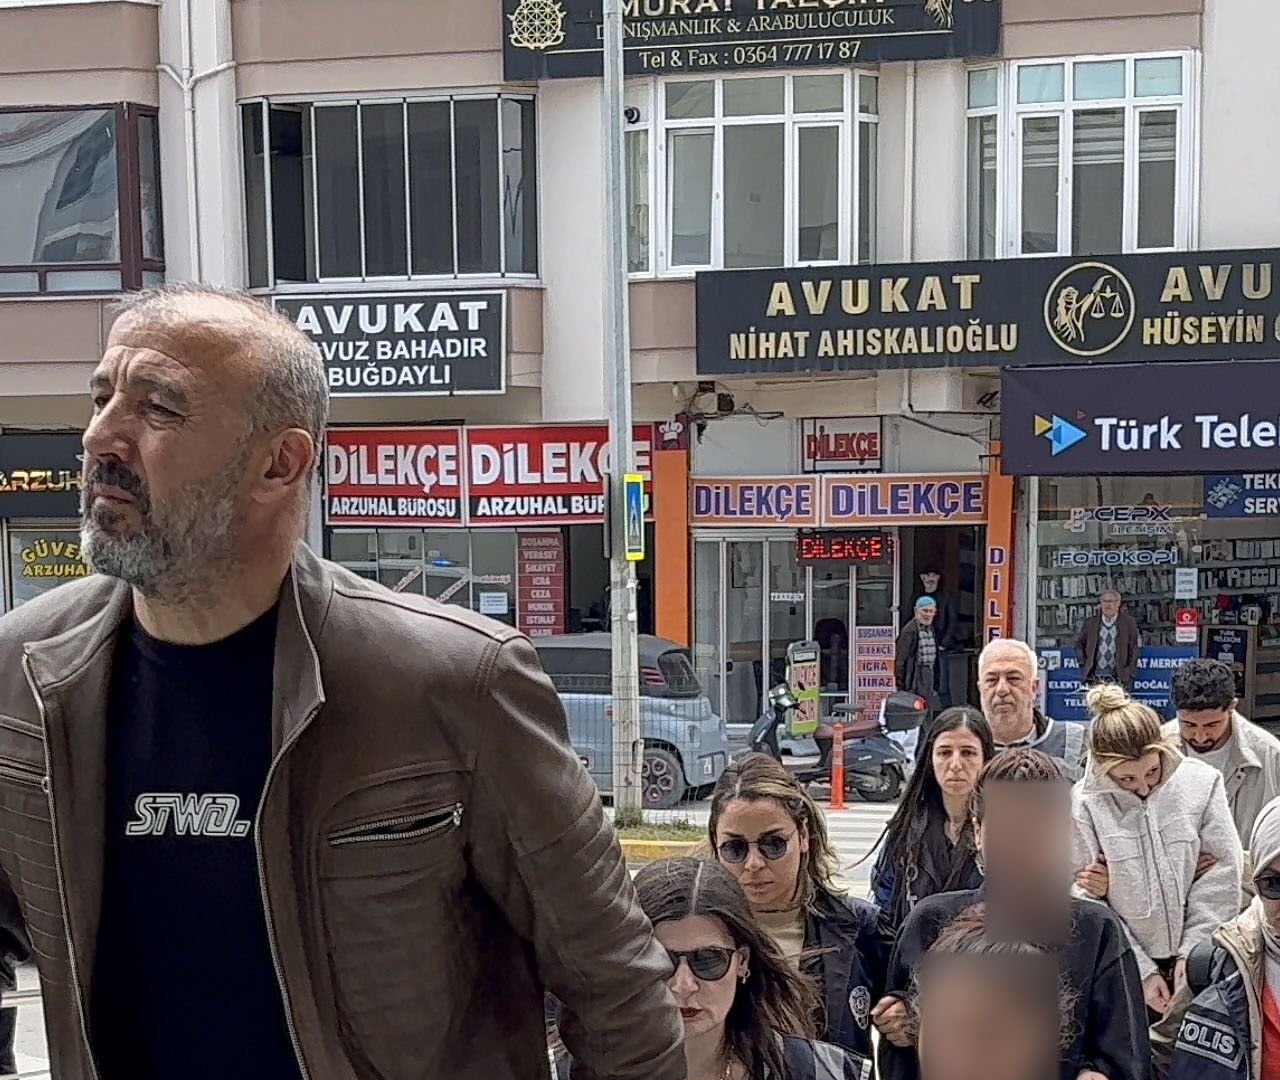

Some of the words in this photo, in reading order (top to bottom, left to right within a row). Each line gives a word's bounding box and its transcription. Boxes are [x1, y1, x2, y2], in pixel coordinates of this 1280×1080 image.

[596, 17, 722, 40] DNIŞMANLIK
[727, 19, 742, 33] &
[745, 9, 895, 32] ARABULUCULUK
[638, 50, 666, 68] Tel
[670, 51, 683, 67] &
[688, 49, 718, 66] Fax
[734, 46, 777, 64] 0364
[783, 43, 813, 61] 777
[818, 42, 832, 60] 17
[839, 40, 861, 59] 87
[766, 274, 981, 317] AVUKAT
[295, 301, 488, 334] AVUKAT
[1142, 309, 1265, 346] HÜSEYİN
[316, 341, 369, 362] VUZ
[376, 337, 488, 360] BAHADIR
[729, 326, 810, 360] NİHAT
[818, 319, 1018, 358] AHISKALIOĞLU
[328, 362, 451, 387] BUĞDAYLI
[1094, 415, 1182, 451] Türk
[328, 444, 457, 494] DİLEKÇE
[331, 498, 396, 517] ARZUHAL
[398, 496, 456, 518] BÜROSU
[477, 497, 562, 516] ARZUHAL
[694, 483, 812, 521] DİLEKÇE
[830, 480, 985, 519] DİLEKÇE
[1056, 547, 1178, 566] FOTOKOPİ
